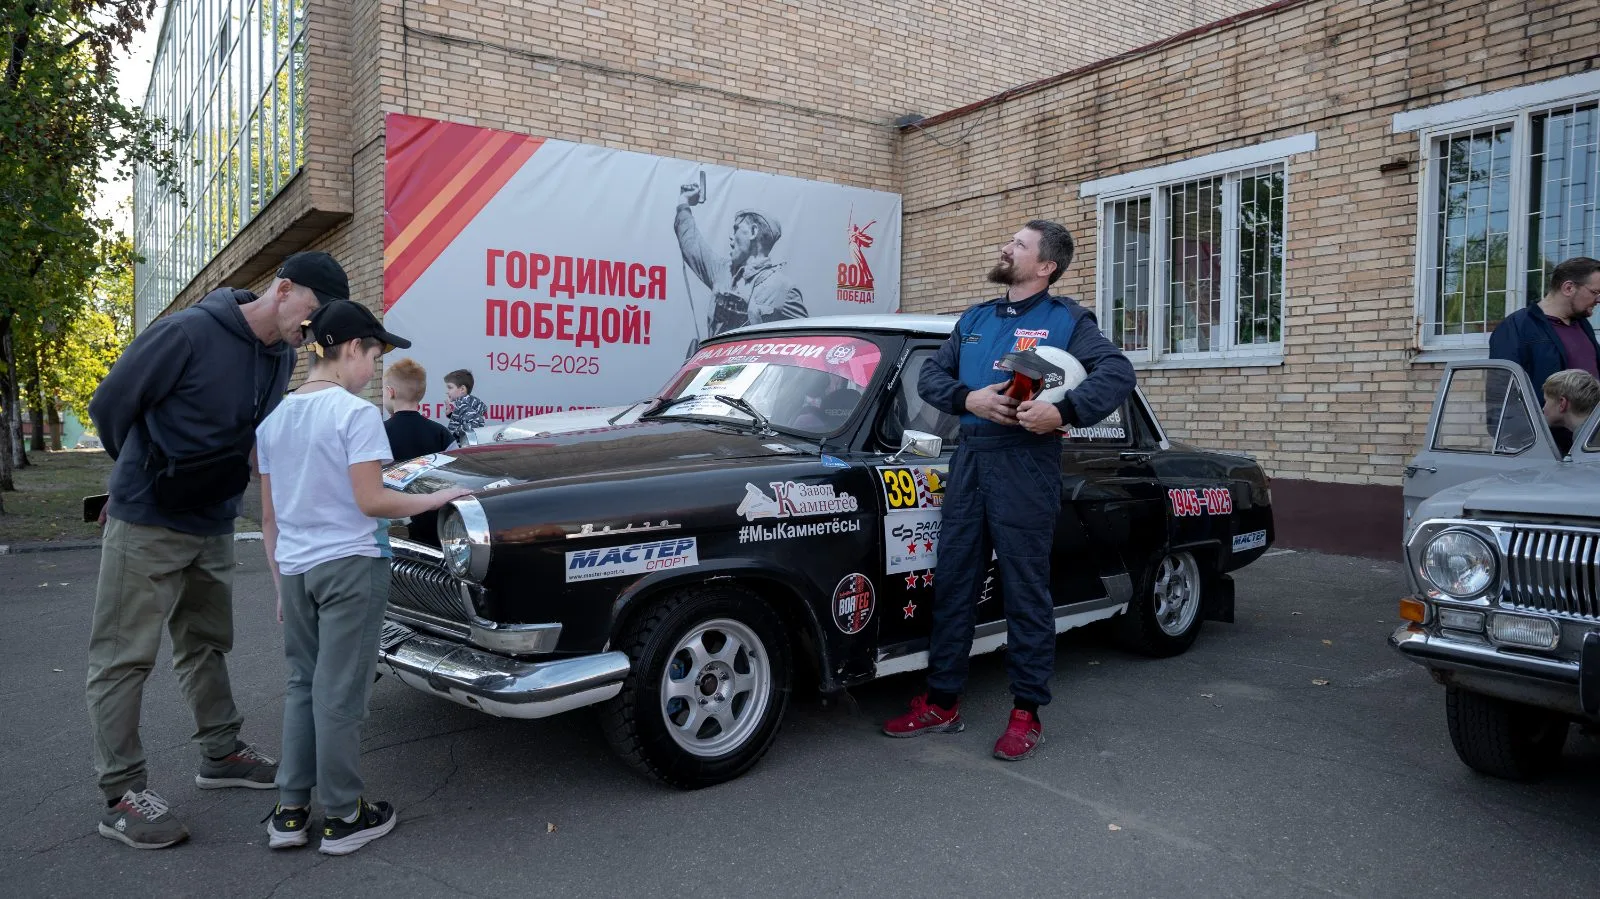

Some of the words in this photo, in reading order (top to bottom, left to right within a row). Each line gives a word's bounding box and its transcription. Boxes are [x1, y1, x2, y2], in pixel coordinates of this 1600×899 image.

[487, 248, 666, 300] ГОРДИМСЯ
[838, 262, 858, 286] 80
[836, 289, 875, 304] ПОБЕДА!
[486, 299, 651, 348] ПОБЕДОЙ!
[746, 343, 825, 358] РОССИИ
[773, 483, 857, 515] Камнетёс
[799, 484, 834, 497] Завод
[884, 470, 916, 507] 39
[738, 518, 861, 543] #МыКамнетёсы
[1234, 531, 1265, 546] МАСТЕР
[569, 539, 695, 570] МАСТЕР
[646, 556, 688, 570] СПОРТ
